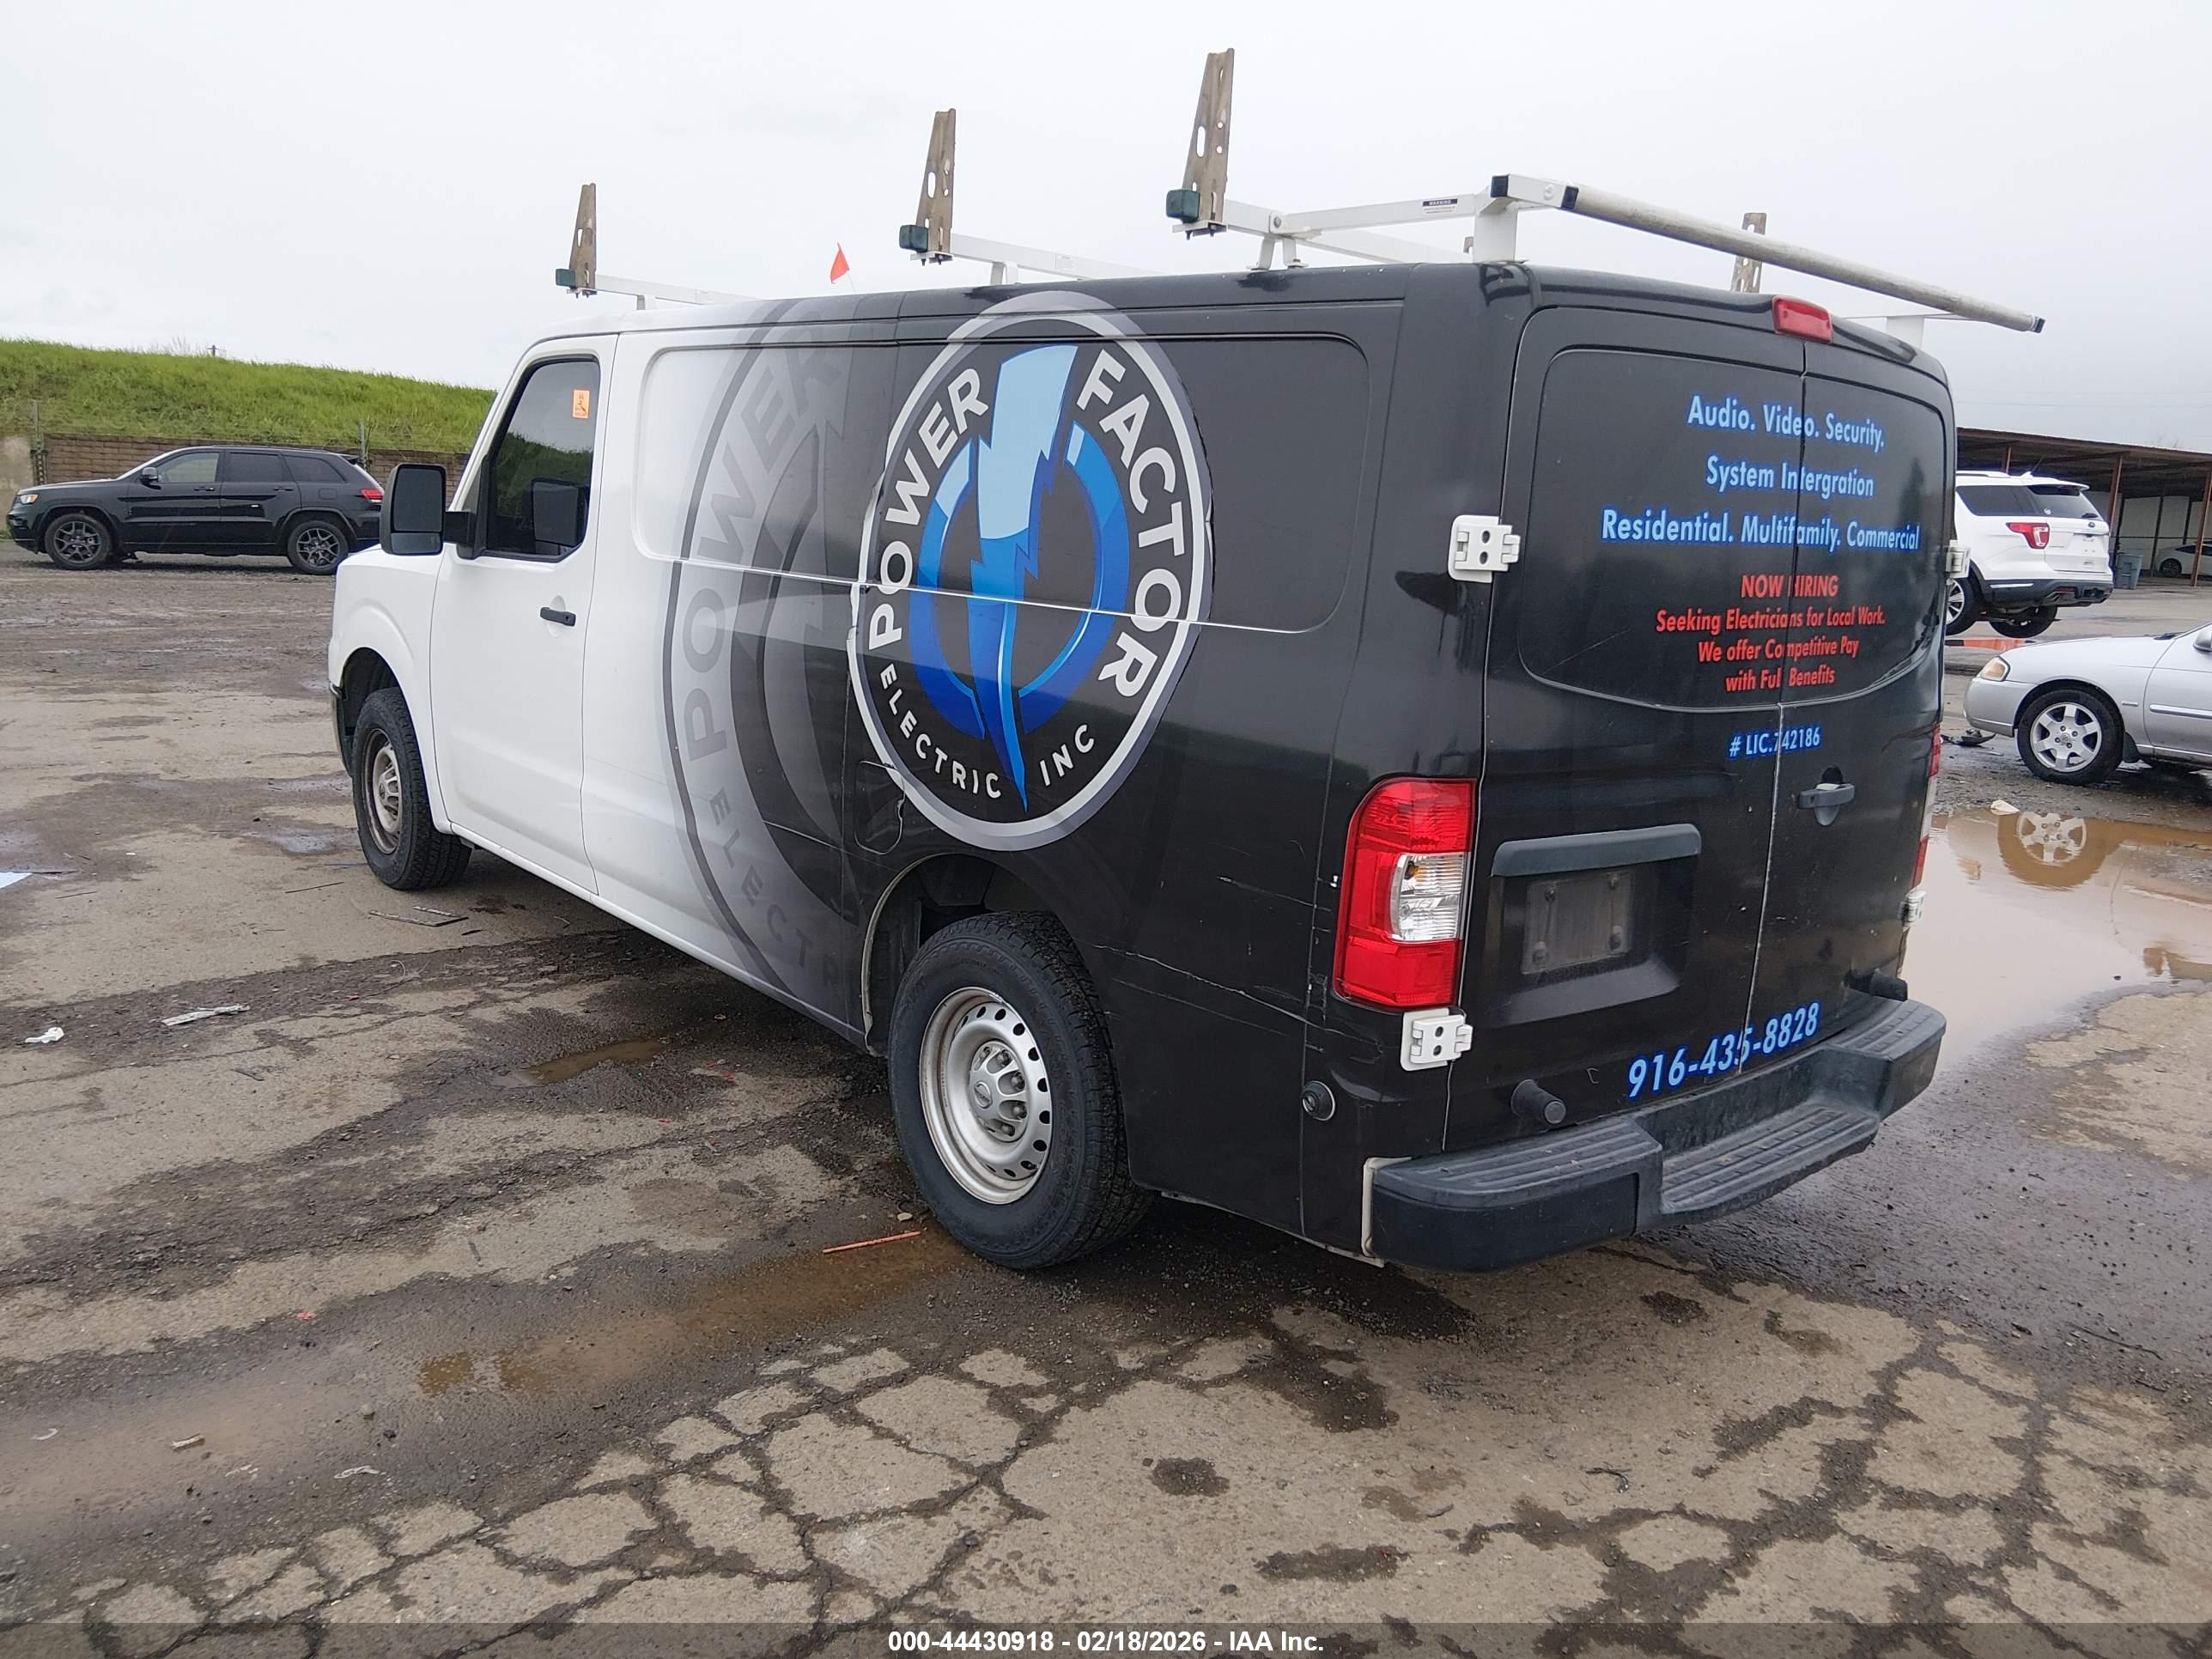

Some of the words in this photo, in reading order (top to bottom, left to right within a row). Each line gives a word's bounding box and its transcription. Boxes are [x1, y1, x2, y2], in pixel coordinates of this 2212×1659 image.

[1687, 396, 1756, 430] Audio.
[1763, 404, 1820, 438] Video.
[1825, 412, 1885, 453] Security.
[1706, 455, 1774, 492] System
[1781, 462, 1874, 499] Intergration
[869, 368, 989, 650] POWER
[1077, 349, 1182, 697] FACTOR
[1602, 509, 1733, 543] Residential.
[1741, 515, 1841, 552] Multifamily.
[1846, 521, 1920, 550] Commercial
[1741, 574, 1784, 598] NOW
[1656, 609, 1721, 637] Seeking
[1726, 608, 1802, 630] Electricians
[1806, 606, 1824, 627] for
[1826, 606, 1854, 626] Local
[1857, 605, 1885, 625] Work.
[1698, 641, 1722, 662] We
[1726, 639, 1760, 661] offer
[1840, 635, 1859, 658] Pay
[1725, 666, 1755, 692] with
[1760, 668, 1782, 690] Ful
[1789, 664, 1835, 686] Benefits
[880, 664, 1002, 799] ELECTRIC
[1039, 723, 1096, 787] INC
[1729, 738, 1741, 757] #
[1628, 1001, 1820, 1097] 916-435-8828
